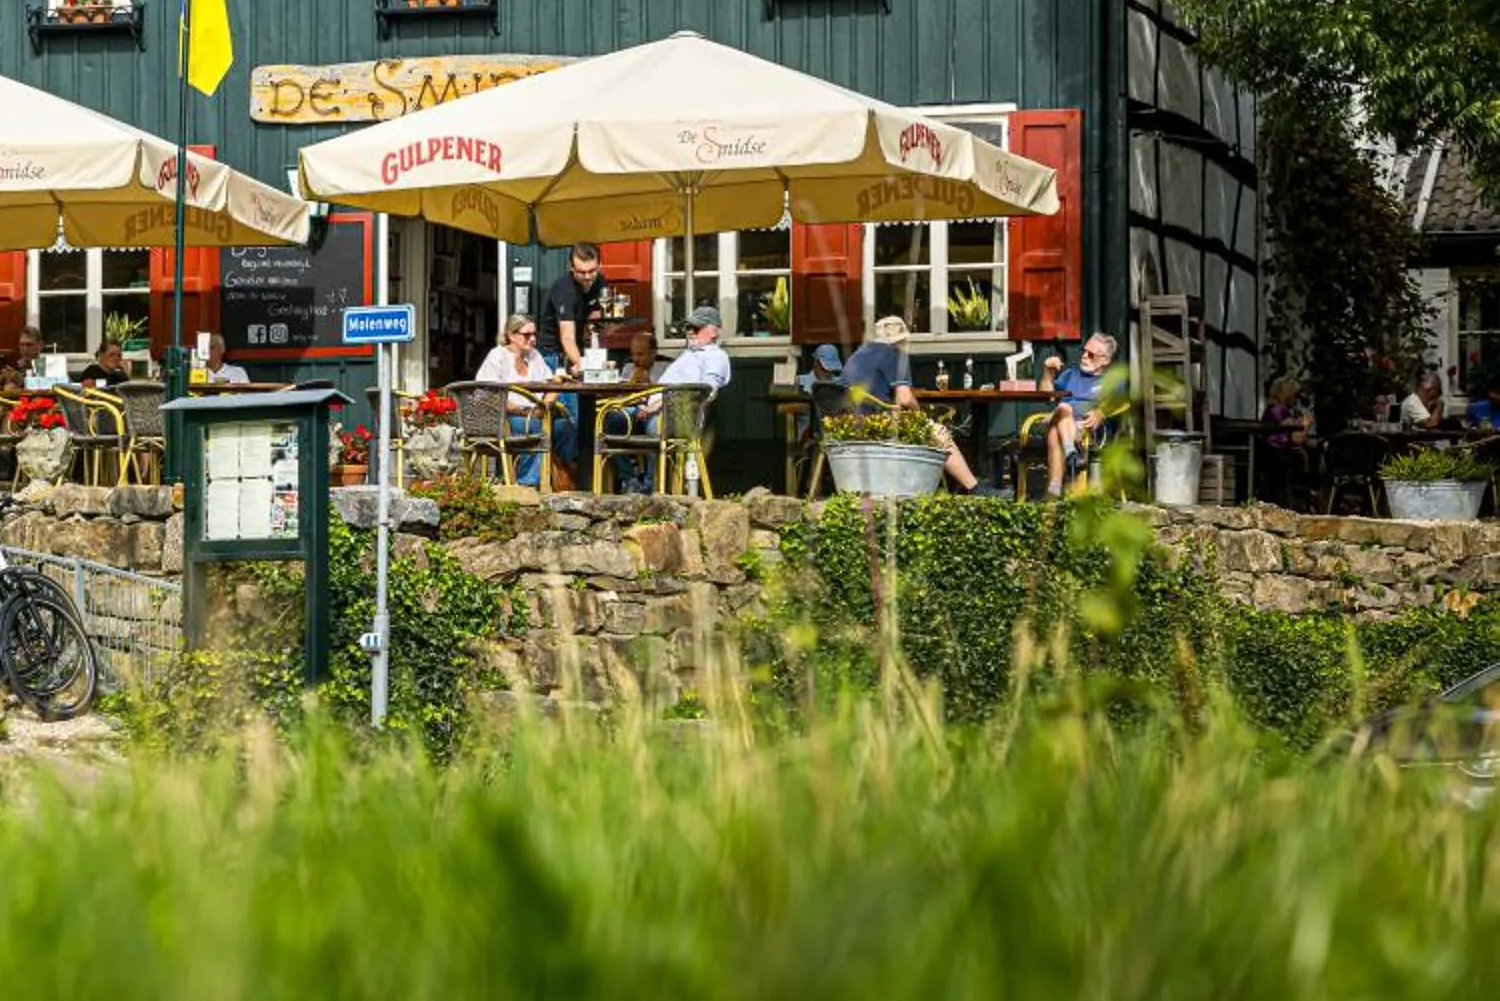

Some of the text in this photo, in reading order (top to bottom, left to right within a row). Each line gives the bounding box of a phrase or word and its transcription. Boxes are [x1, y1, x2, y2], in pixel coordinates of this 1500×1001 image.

[268, 78, 341, 117] DE
[381, 136, 502, 185] GULPENER
[695, 126, 767, 164] Smidse
[348, 317, 406, 333] Molenweg
